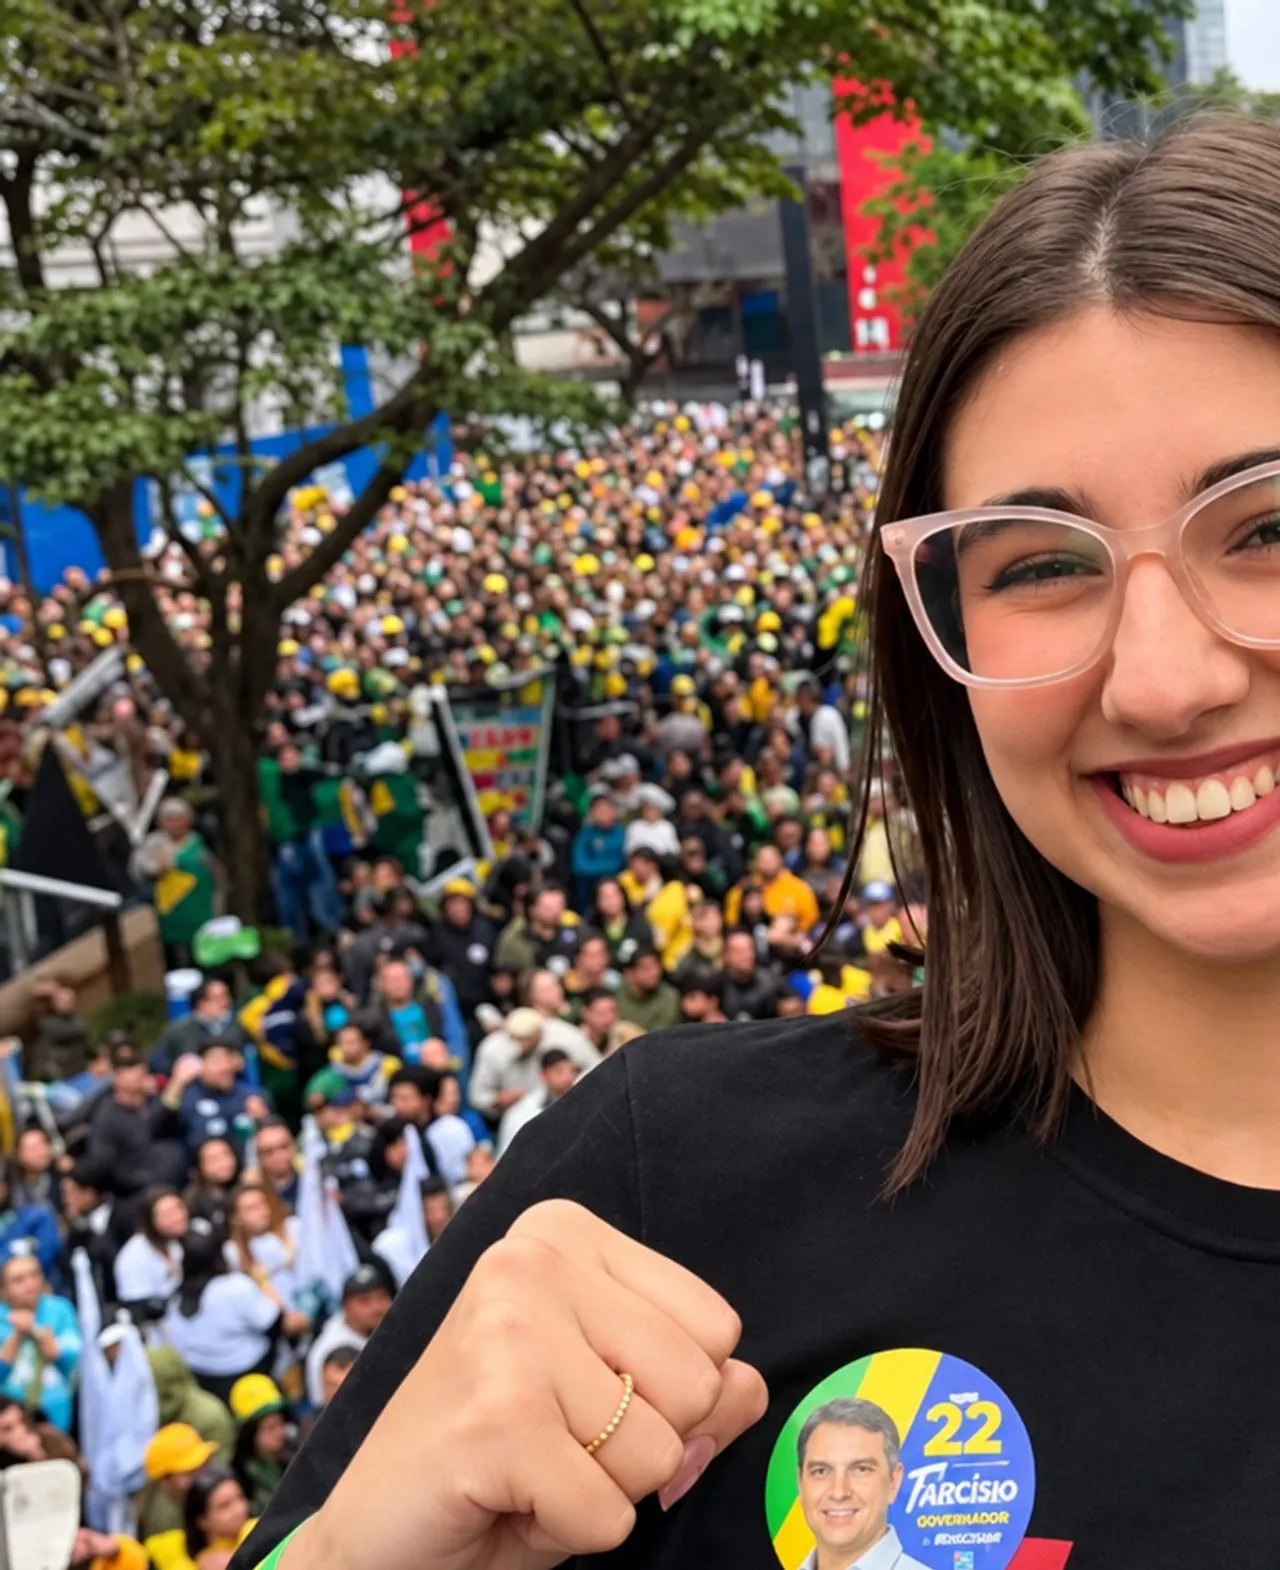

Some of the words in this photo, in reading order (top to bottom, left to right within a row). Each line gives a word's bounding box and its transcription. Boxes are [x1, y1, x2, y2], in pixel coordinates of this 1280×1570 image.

[923, 1400, 1002, 1457] 22
[905, 1462, 1018, 1514] TARCÍSIO
[916, 1511, 1010, 1528] GOVERNADOR
